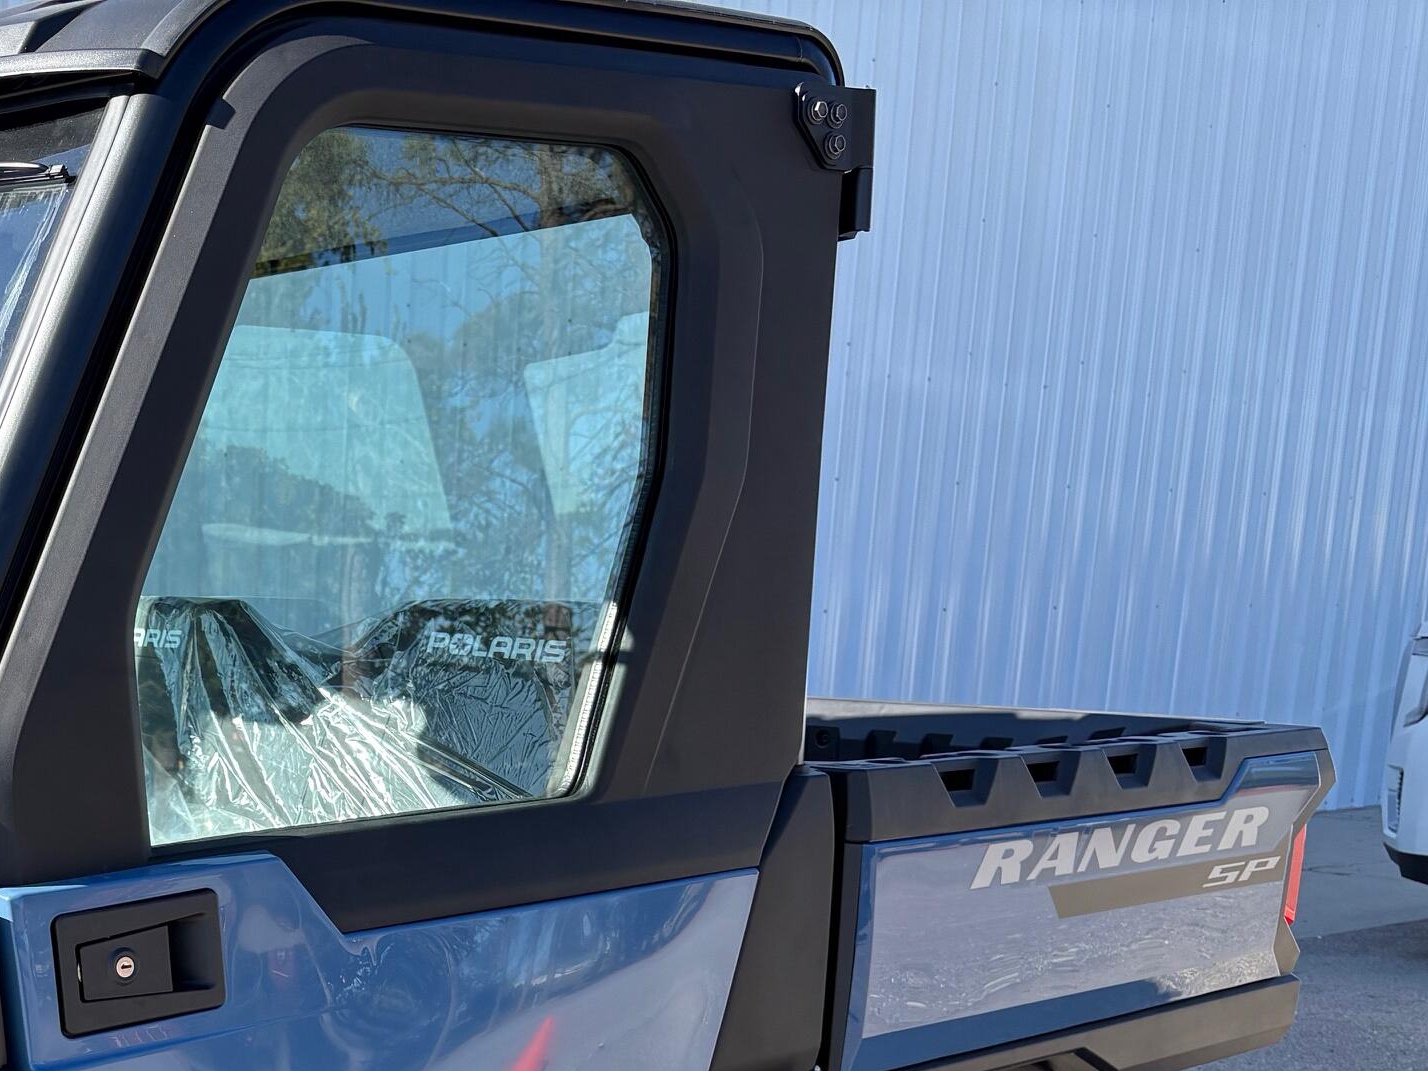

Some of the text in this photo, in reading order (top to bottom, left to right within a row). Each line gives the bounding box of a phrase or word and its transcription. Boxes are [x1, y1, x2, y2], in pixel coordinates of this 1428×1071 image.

[133, 627, 183, 649] ARIS
[426, 630, 567, 664] POLARIS
[970, 805, 1270, 890] RANGER
[1202, 855, 1280, 888] SP
